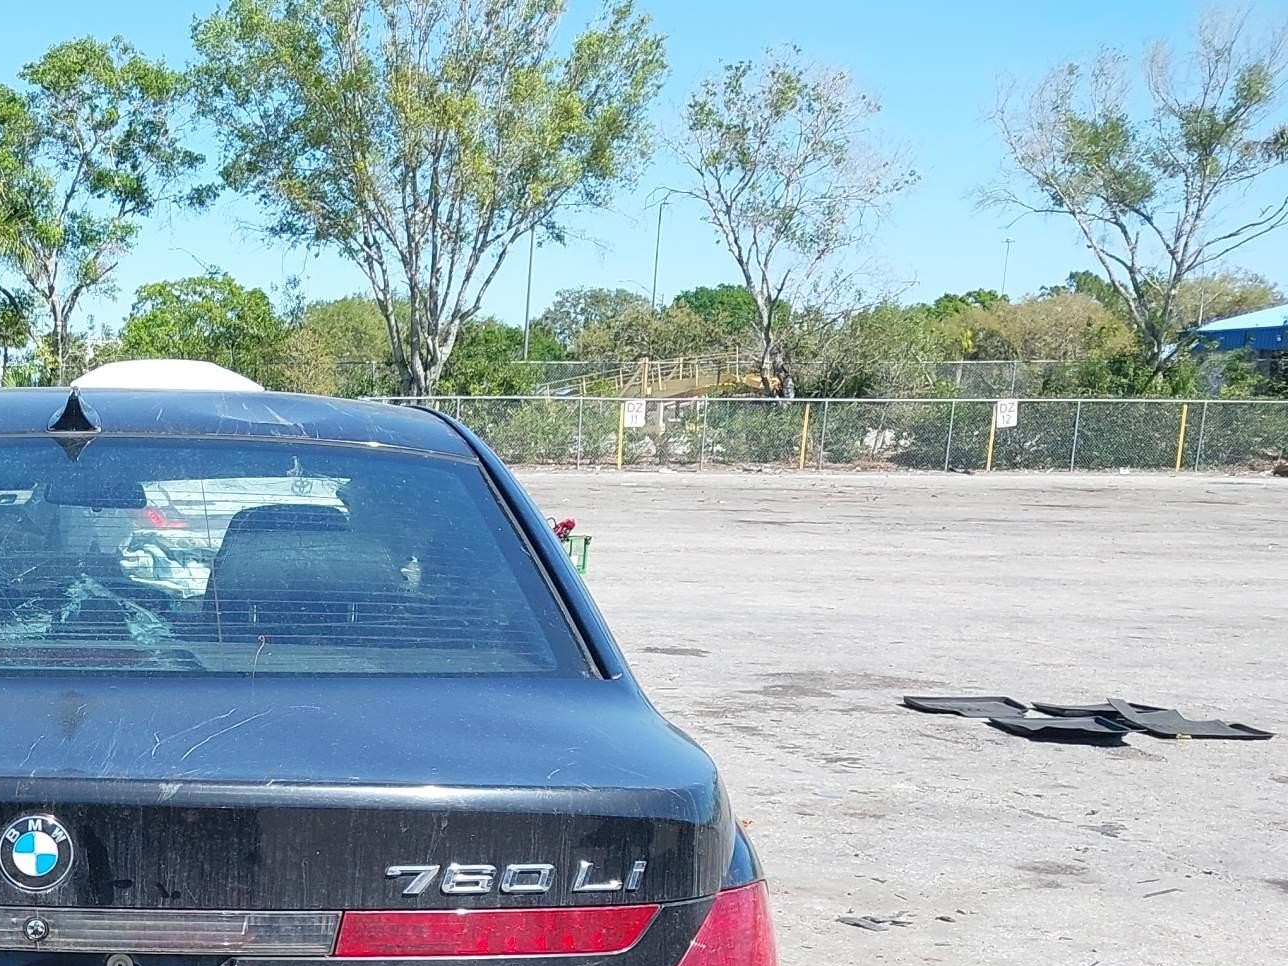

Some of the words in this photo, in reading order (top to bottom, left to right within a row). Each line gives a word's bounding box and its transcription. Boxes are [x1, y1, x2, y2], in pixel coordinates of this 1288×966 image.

[627, 402, 643, 413] DZ
[1000, 402, 1016, 414] DZ
[5, 818, 67, 844] BMW
[384, 862, 558, 897] 760
[571, 859, 648, 893] Li
